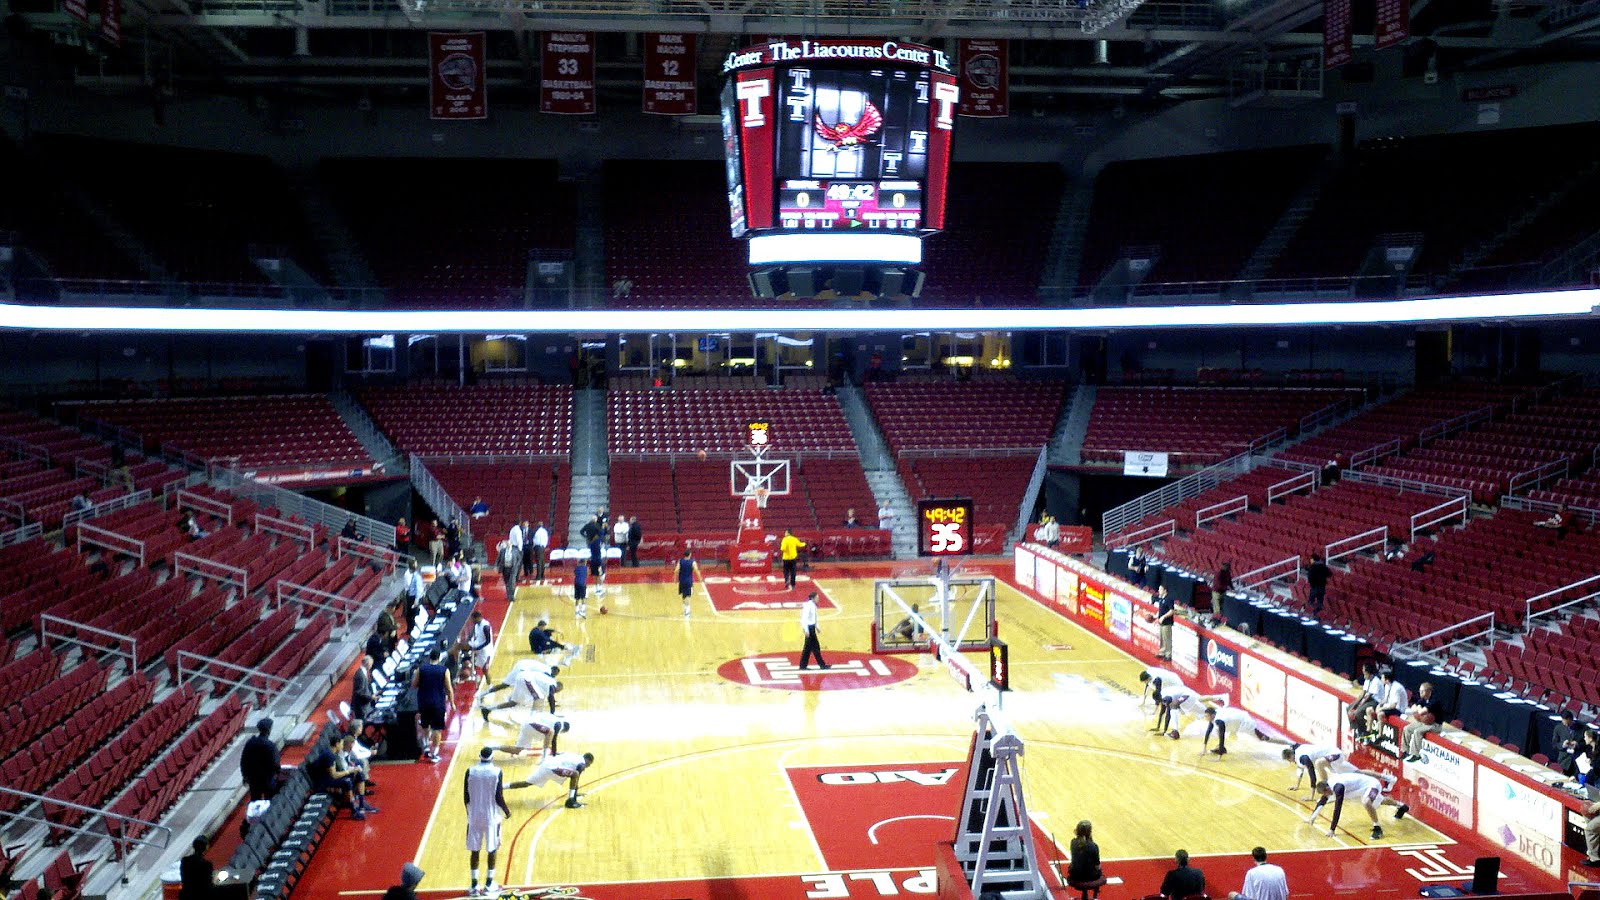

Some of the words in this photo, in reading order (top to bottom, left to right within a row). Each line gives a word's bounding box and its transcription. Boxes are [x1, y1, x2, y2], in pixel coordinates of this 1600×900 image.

[769, 43, 803, 60] The
[802, 40, 883, 59] Liacouras
[883, 42, 930, 63] Center
[558, 58, 579, 75] 33
[662, 60, 679, 76] 12
[736, 79, 770, 128] T
[936, 82, 960, 130] T
[796, 192, 810, 208] 0
[892, 193, 906, 208] 0
[926, 507, 965, 523] 49:42
[931, 523, 963, 552] 35
